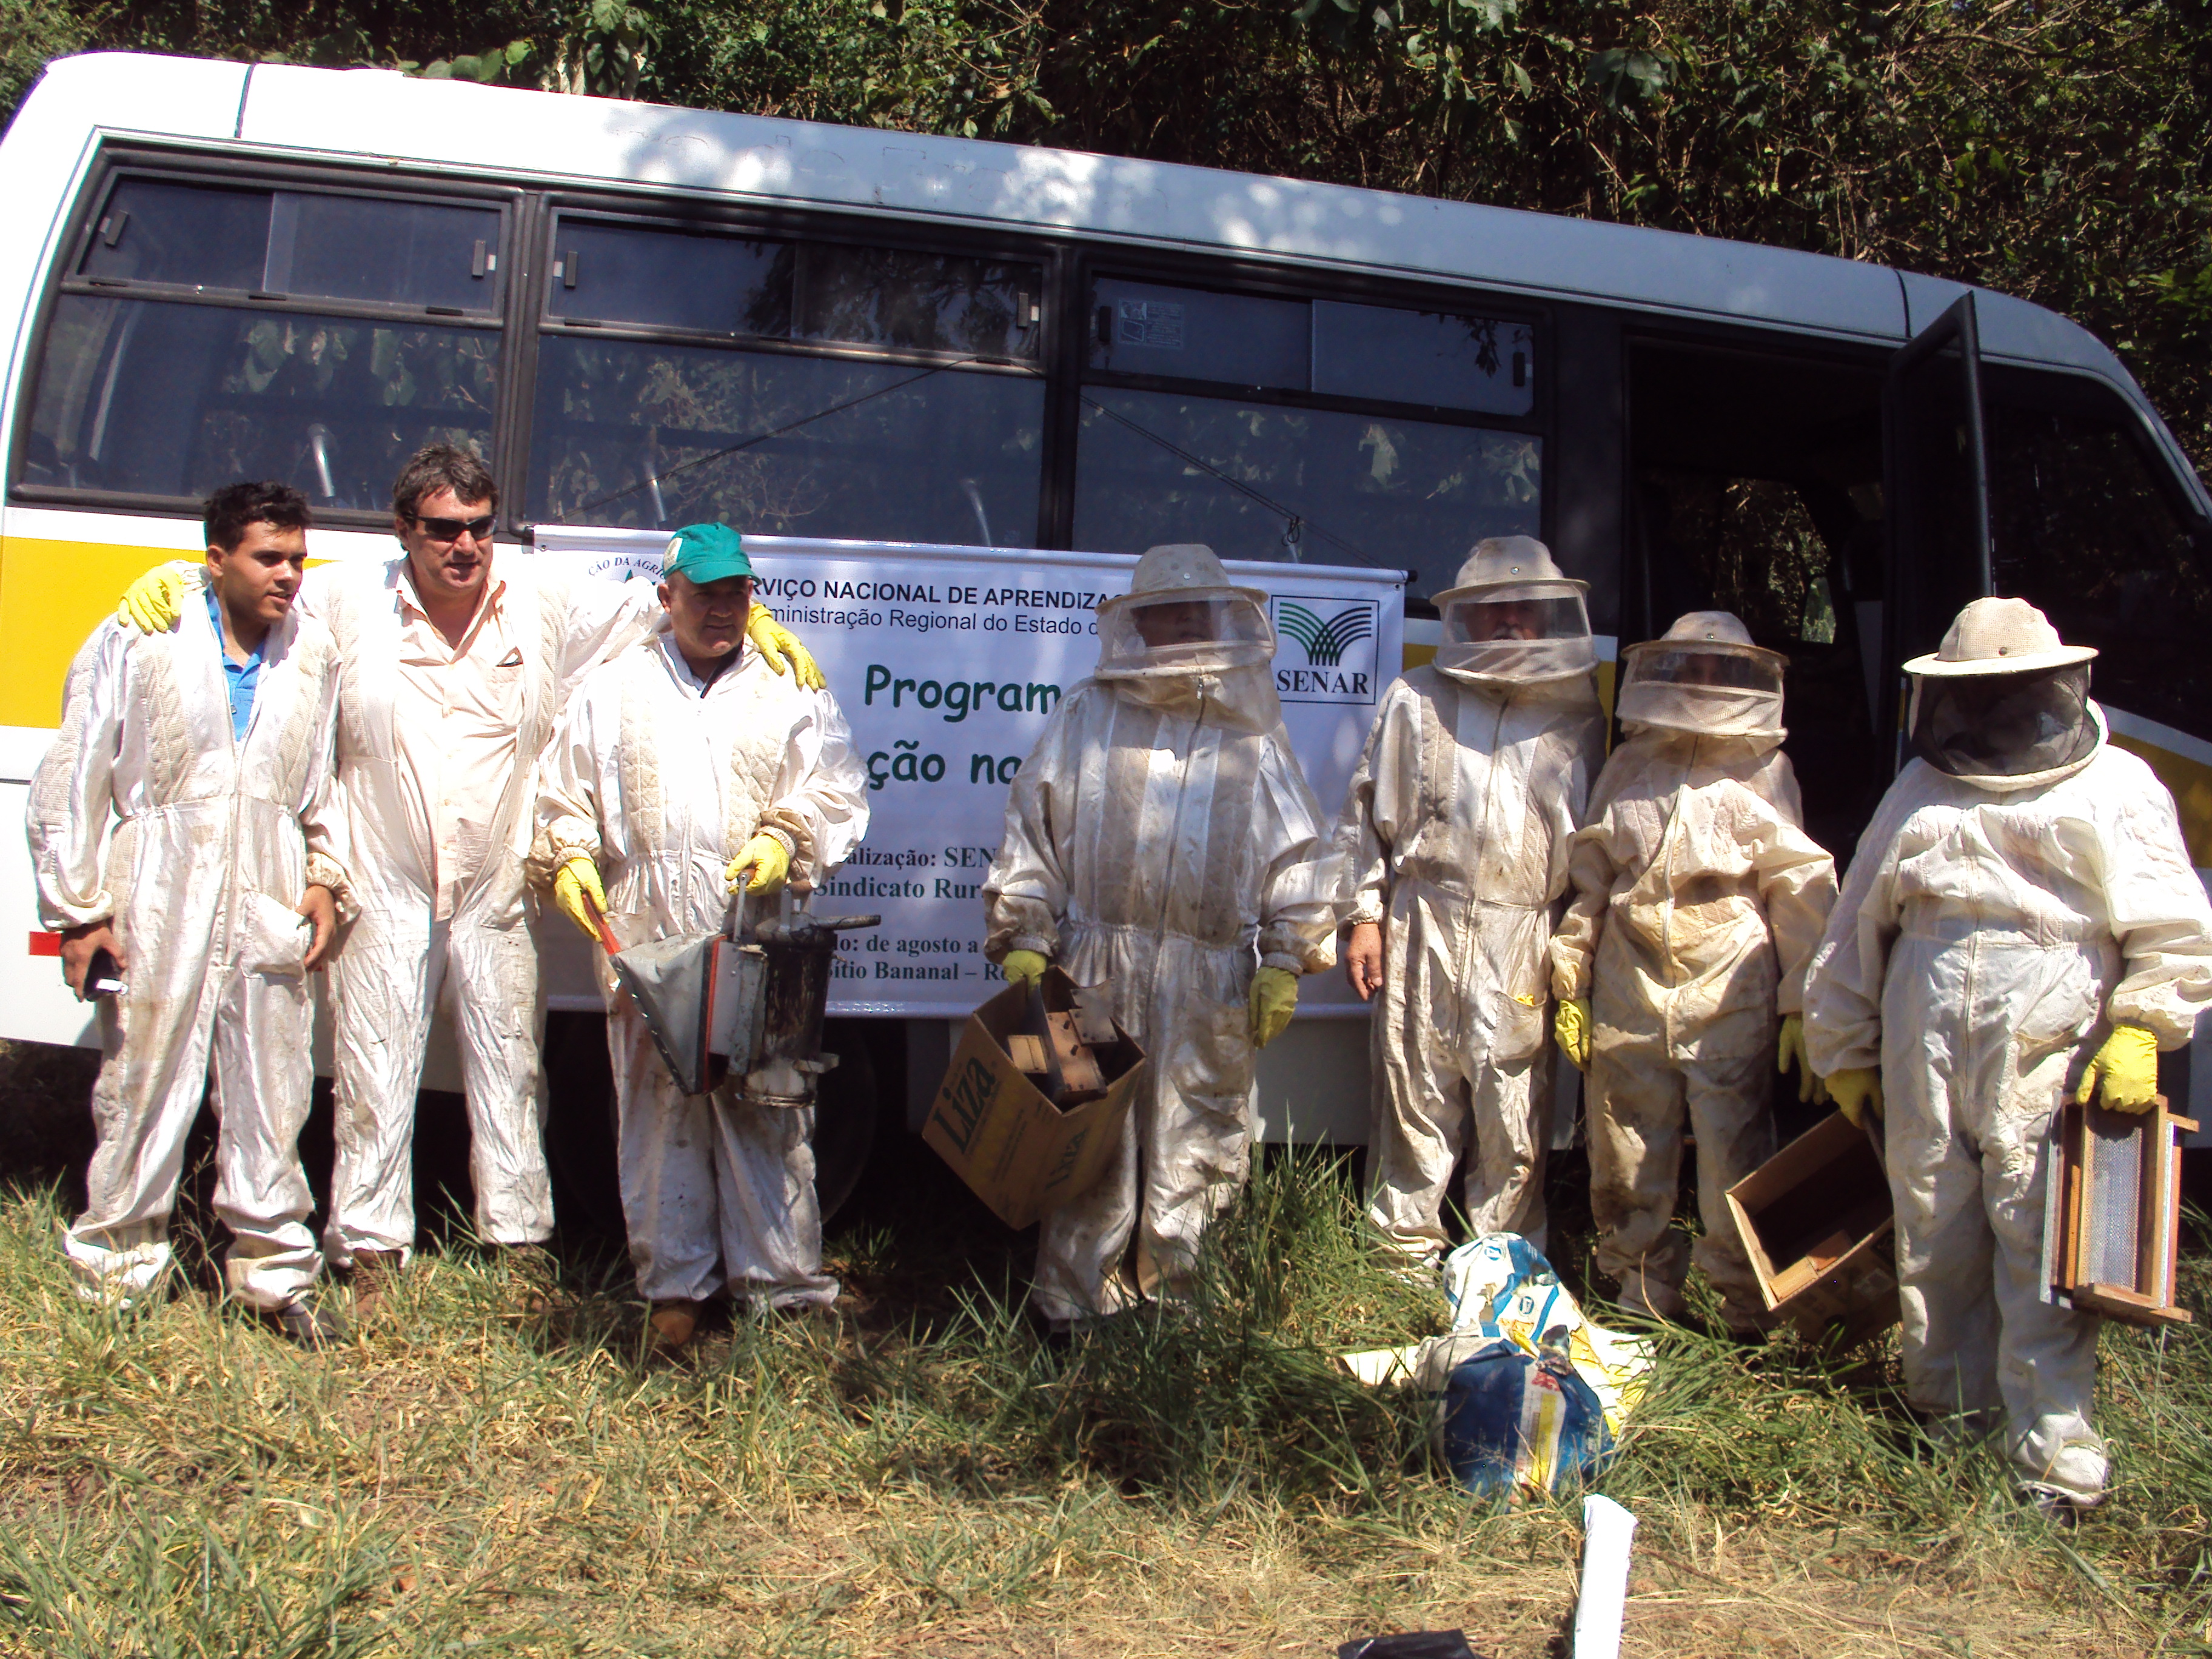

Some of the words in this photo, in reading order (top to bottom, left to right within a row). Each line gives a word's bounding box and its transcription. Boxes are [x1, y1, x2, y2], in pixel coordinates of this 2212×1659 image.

[614, 557, 629, 566] DA
[823, 580, 940, 603] NACIONAL
[948, 586, 977, 605] DE
[763, 605, 882, 629] ministração
[890, 609, 976, 632] Regional
[983, 611, 1007, 631] do
[1015, 615, 1082, 634] Estado
[865, 665, 1061, 722] Program
[1276, 669, 1369, 695] SENAR
[814, 876, 925, 898] Sindicato
[934, 878, 983, 899] Rur
[866, 934, 890, 952] de
[897, 937, 960, 958] agosto
[968, 940, 978, 953] a
[830, 961, 866, 979] ítio
[875, 961, 958, 980] Bananal
[933, 1057, 996, 1154] Liza
